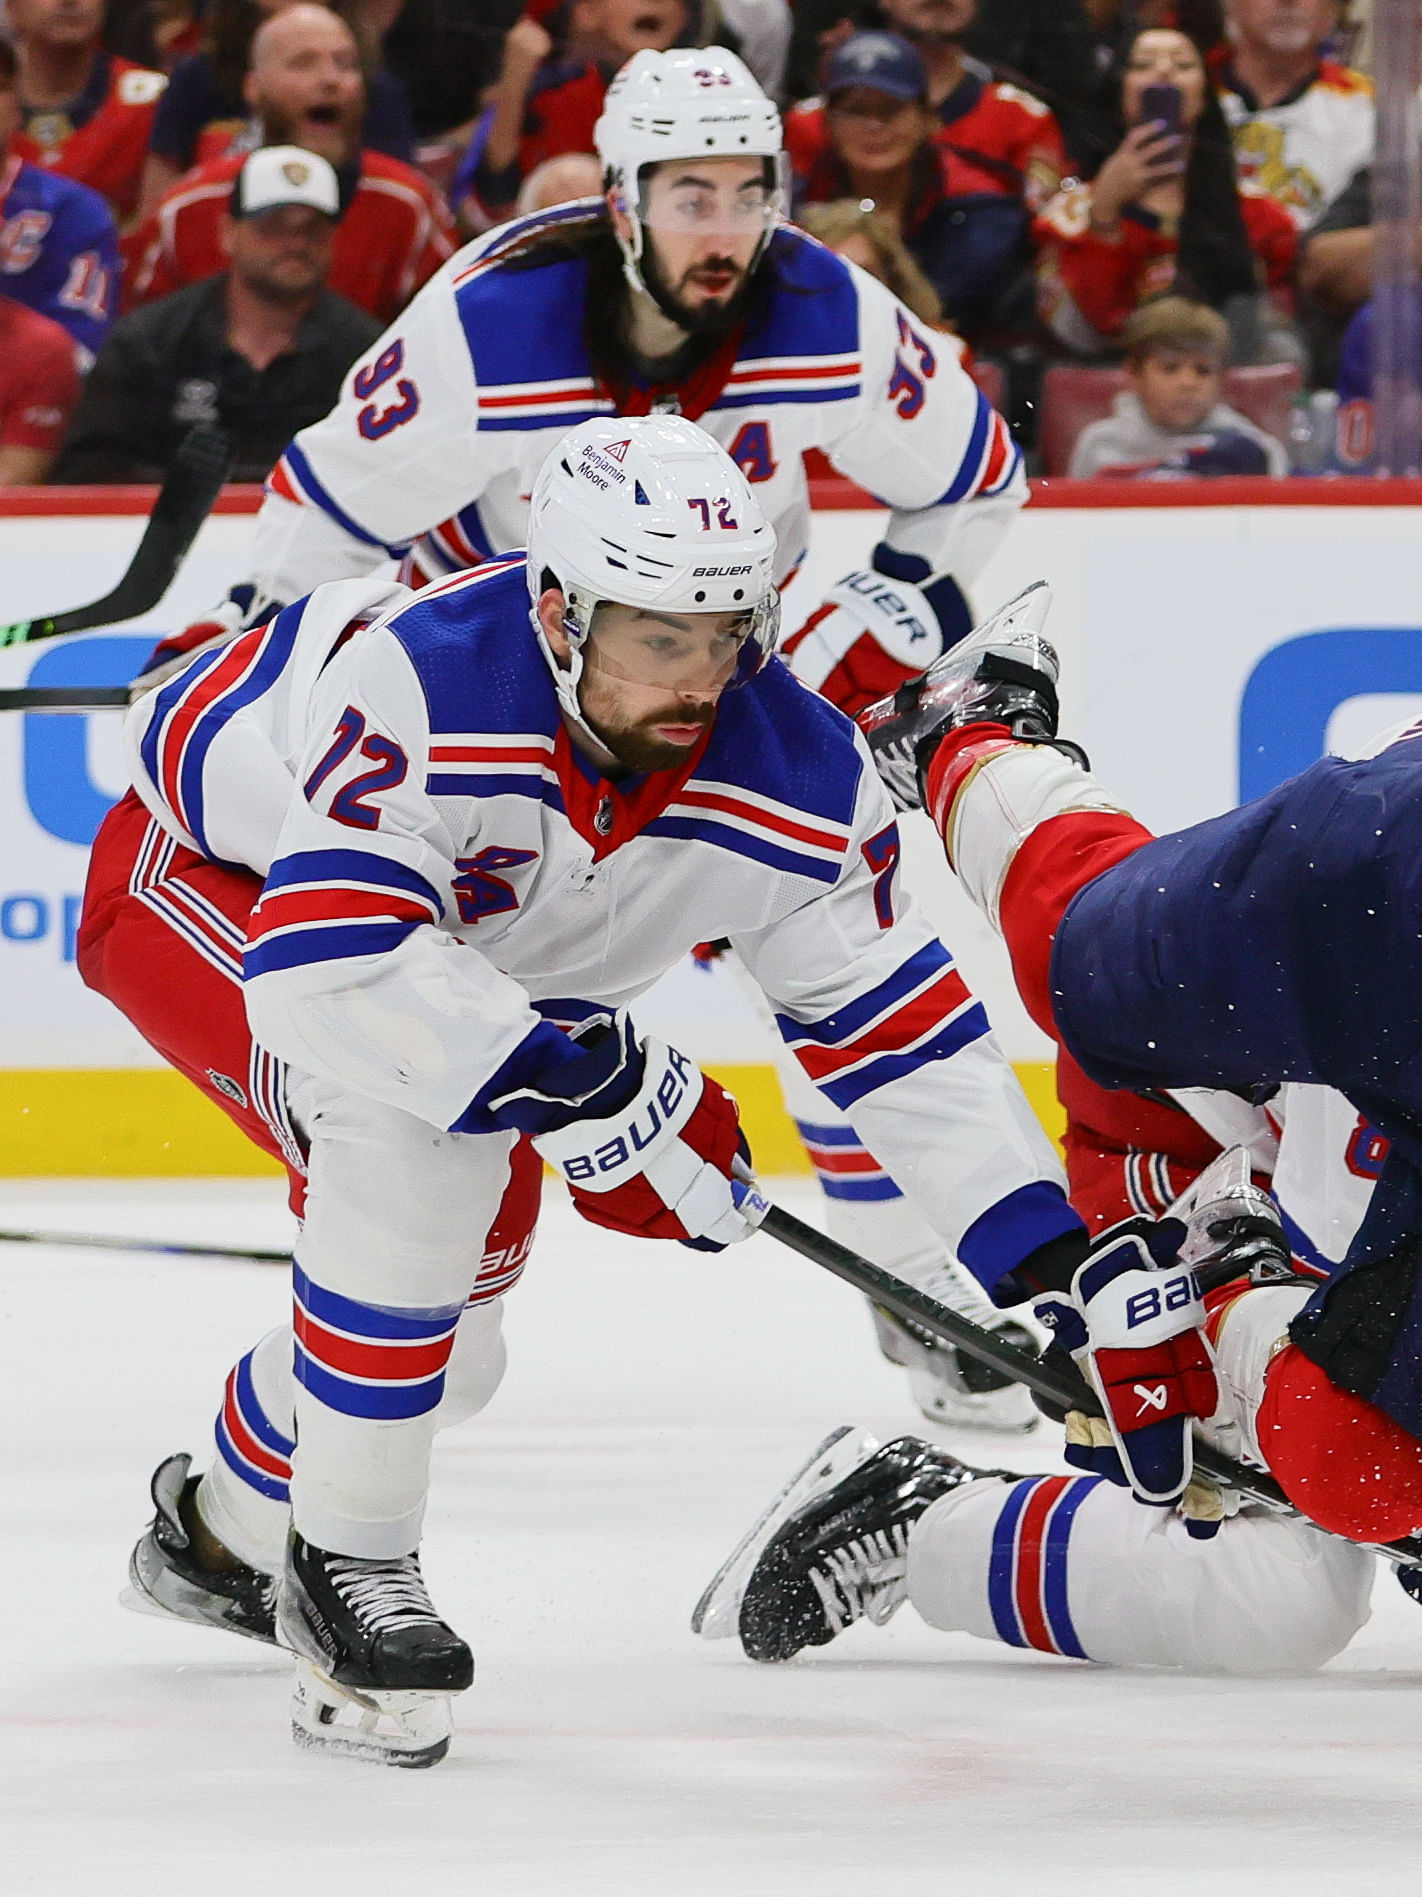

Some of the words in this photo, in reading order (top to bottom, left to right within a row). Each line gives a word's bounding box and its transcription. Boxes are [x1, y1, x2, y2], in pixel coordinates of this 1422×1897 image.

[353, 337, 421, 442] 93
[577, 462, 610, 492] Moore
[582, 445, 627, 485] Benjamin
[727, 420, 779, 484] A
[687, 497, 739, 531] 72
[692, 565, 753, 578] BAUER
[837, 571, 929, 643] UER
[304, 704, 409, 830] 72
[563, 1045, 692, 1181] BAUER
